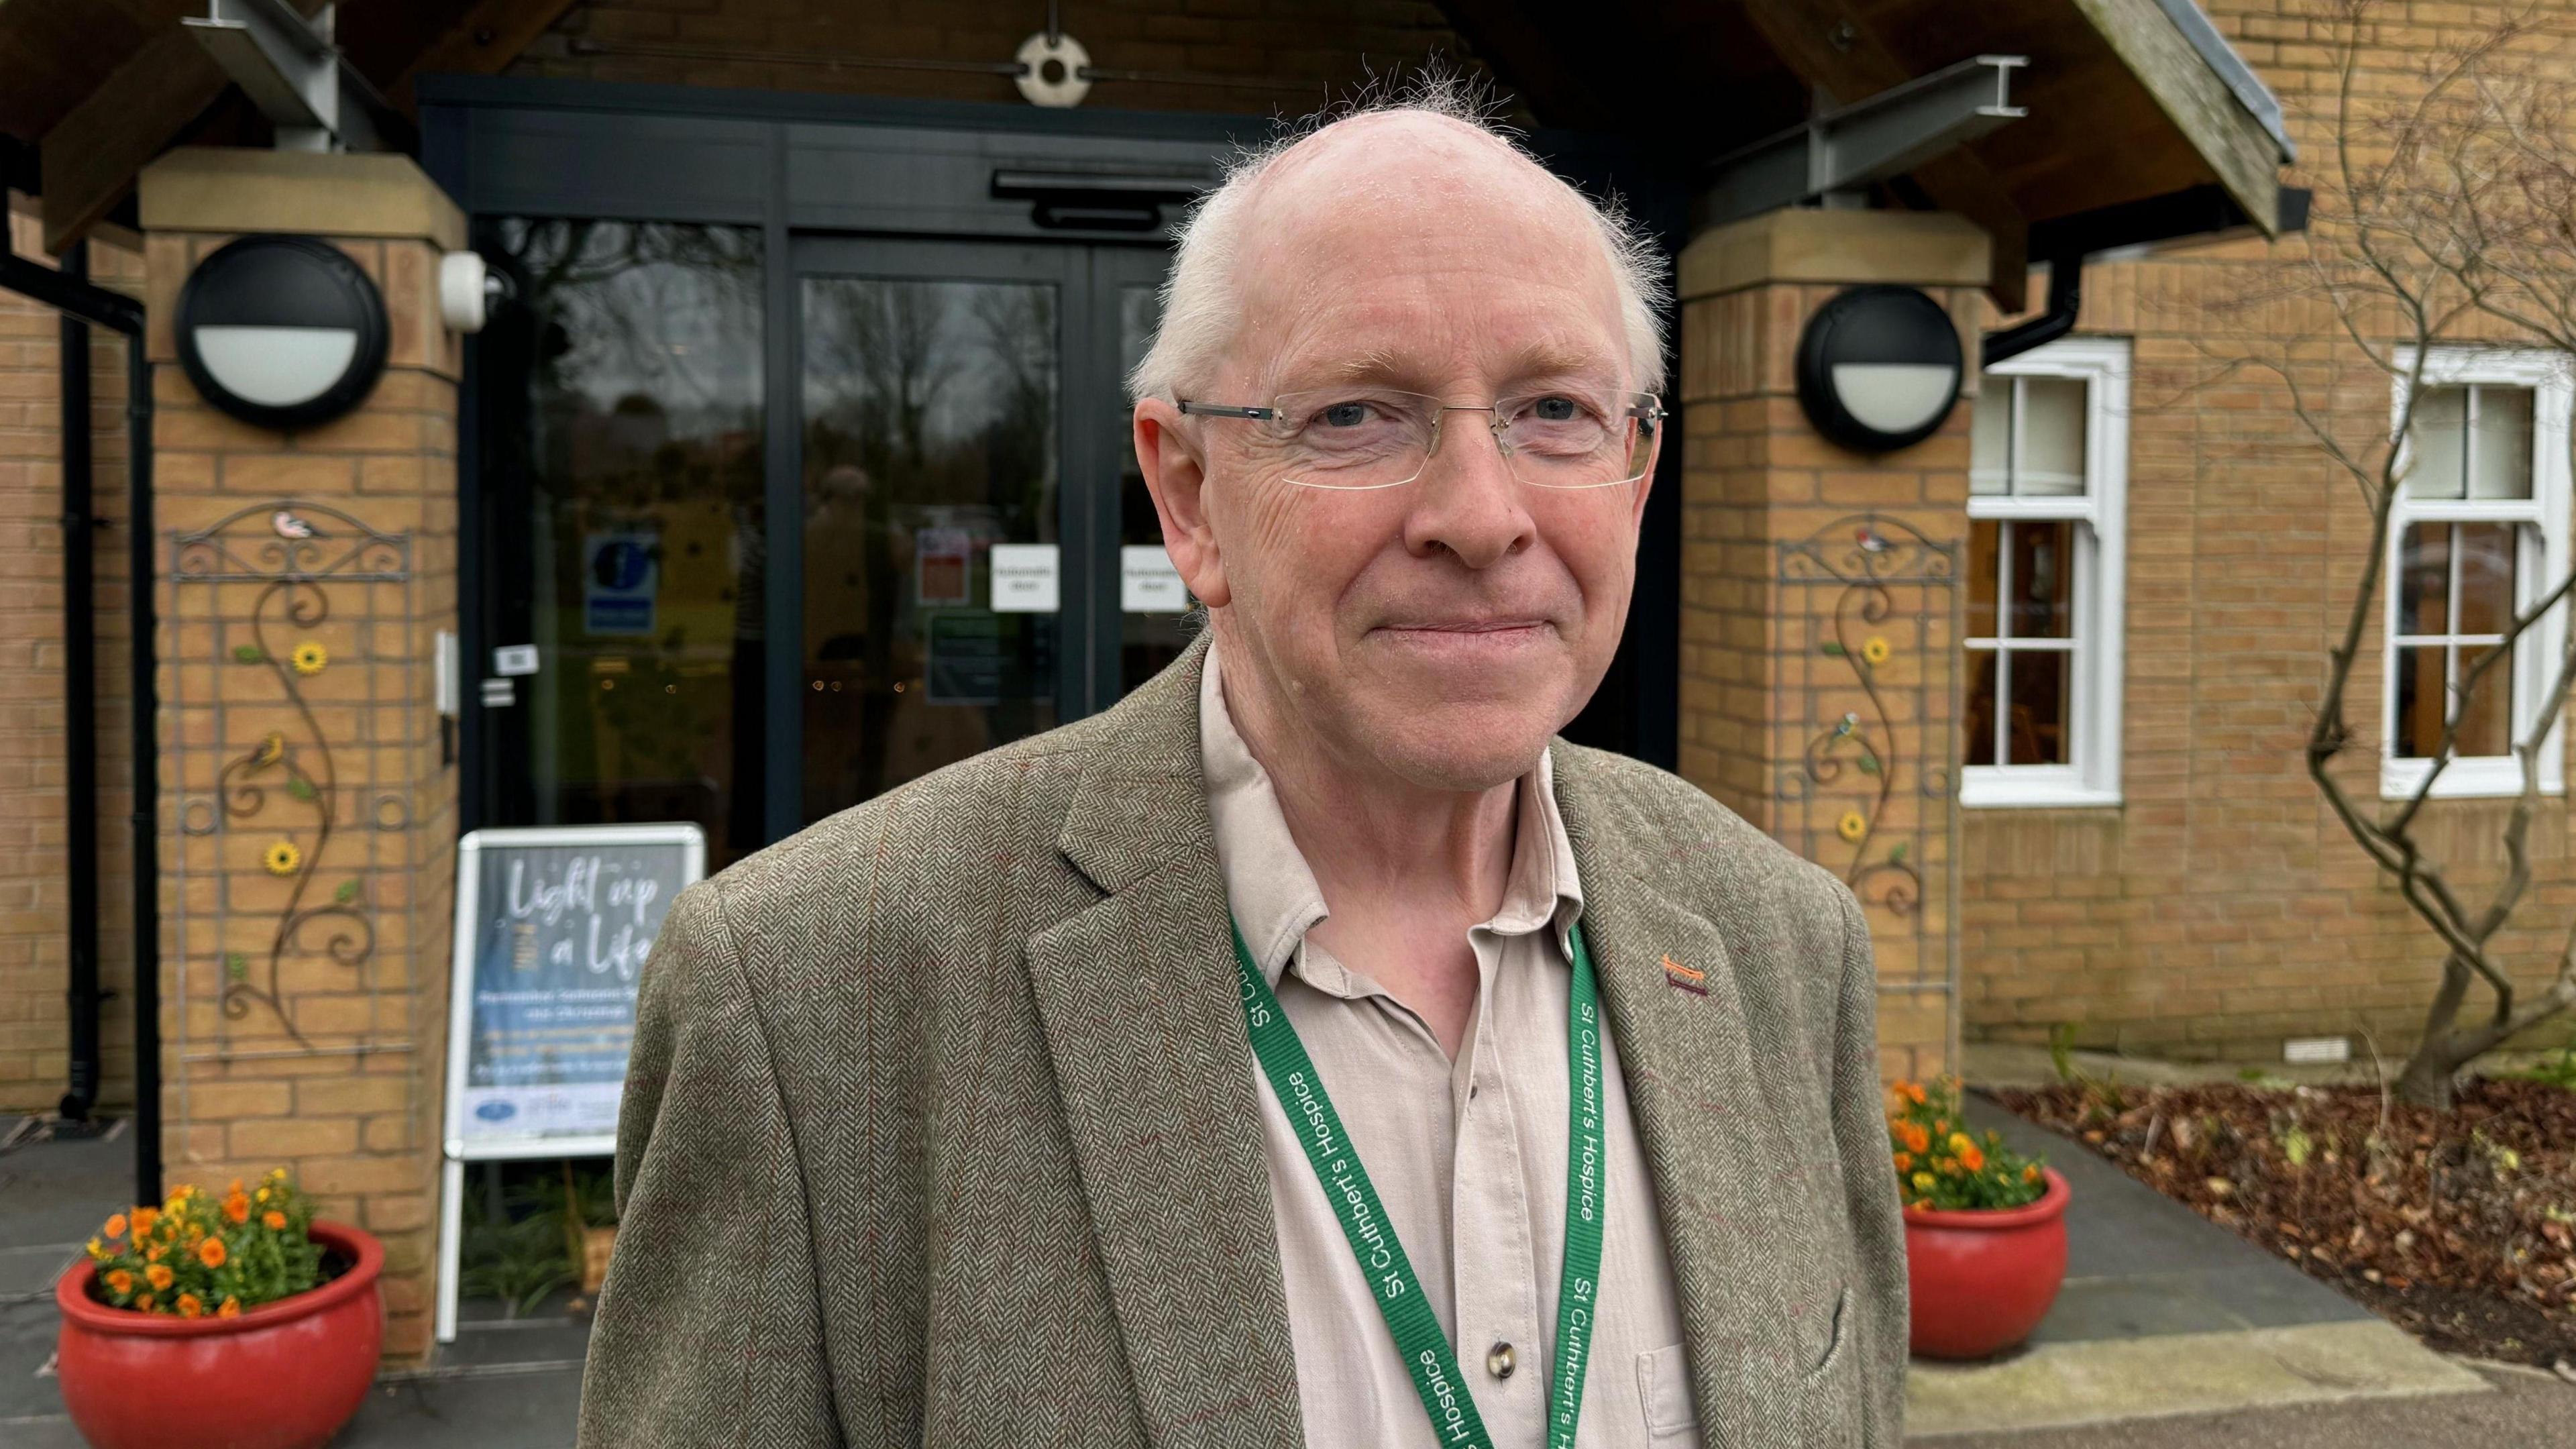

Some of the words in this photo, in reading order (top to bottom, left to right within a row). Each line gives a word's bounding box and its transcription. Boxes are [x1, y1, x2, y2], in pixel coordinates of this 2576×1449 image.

[508, 855, 619, 926] Light
[607, 878, 659, 926] up
[550, 937, 574, 965] a
[587, 913, 652, 981] Life
[1250, 1001, 1271, 1027] St
[1580, 1002, 1594, 1024] St
[1288, 1071, 1338, 1157] Hospice
[1580, 1028, 1599, 1130] Cuthbert's
[1332, 1159, 1391, 1269] Cuthbert's
[1578, 1135, 1598, 1222] Hospice
[1383, 1271, 1405, 1299] St
[1573, 1277, 1591, 1303] St
[1419, 1349, 1470, 1442] Hospice
[1560, 1308, 1587, 1425] Cuthbert's
